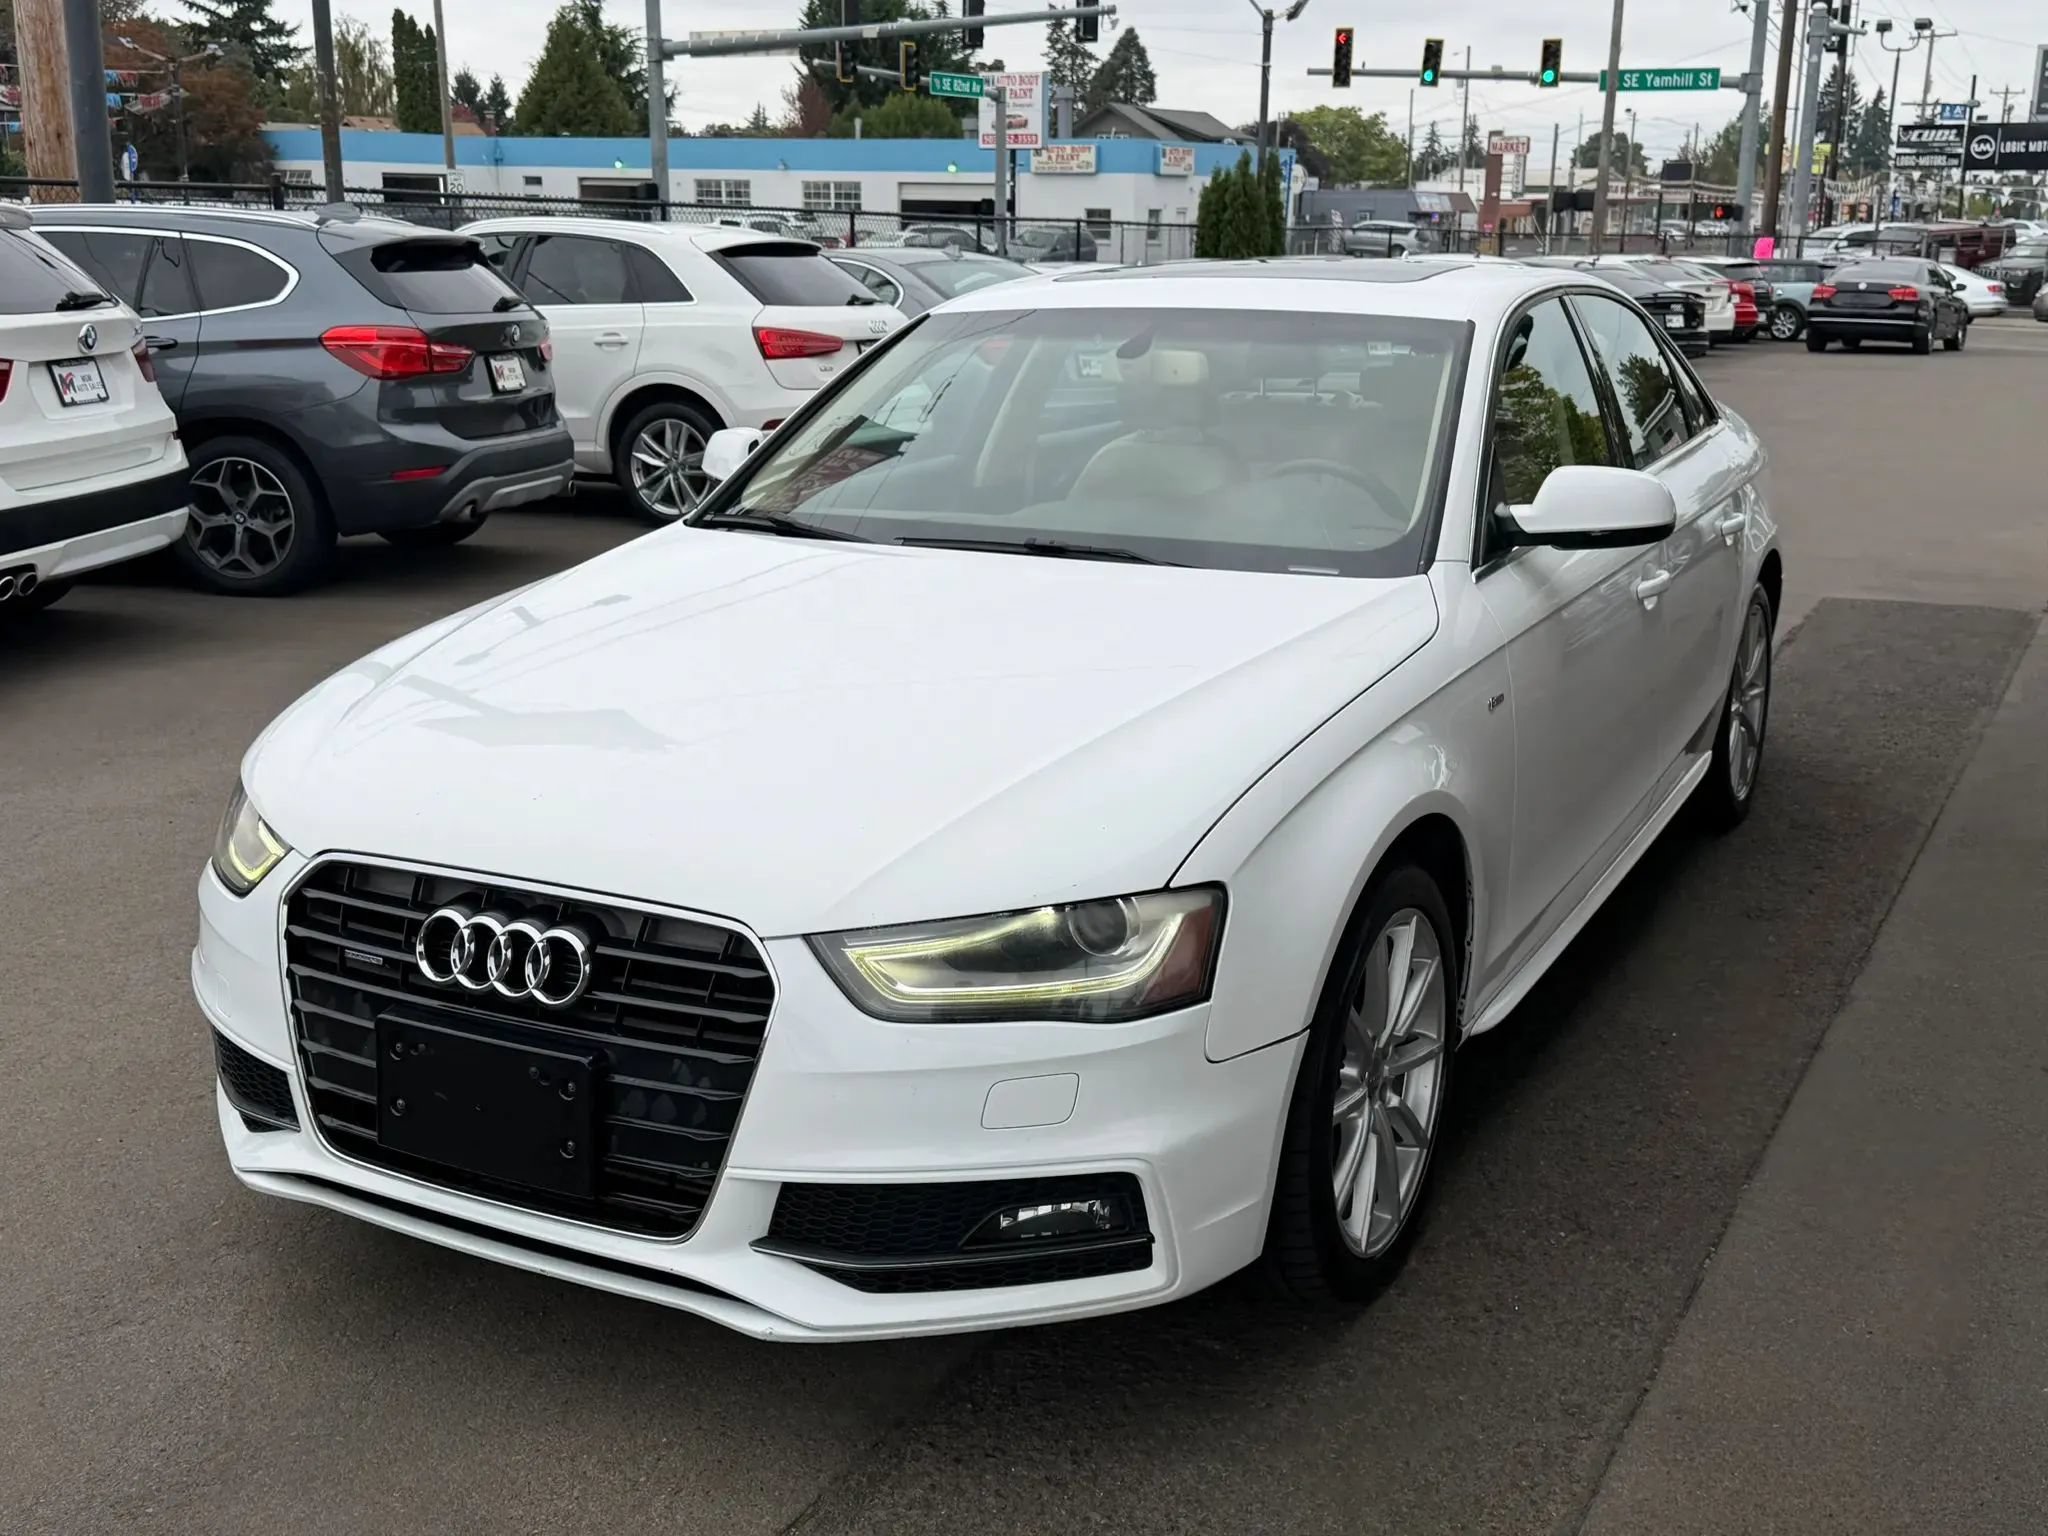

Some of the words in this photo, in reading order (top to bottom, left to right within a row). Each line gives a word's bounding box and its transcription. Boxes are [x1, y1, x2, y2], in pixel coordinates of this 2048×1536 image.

[942, 78, 952, 91] SE
[953, 79, 970, 93] 82nd
[1622, 73, 1640, 88] SE
[1645, 72, 1694, 88] Yamhill
[1698, 72, 1713, 86] St
[1009, 87, 1033, 99] PAINT
[1492, 142, 1526, 153] MARKET
[2000, 140, 2027, 153] LOGIC
[2028, 139, 2048, 152] MOT
[450, 183, 464, 193] 20
